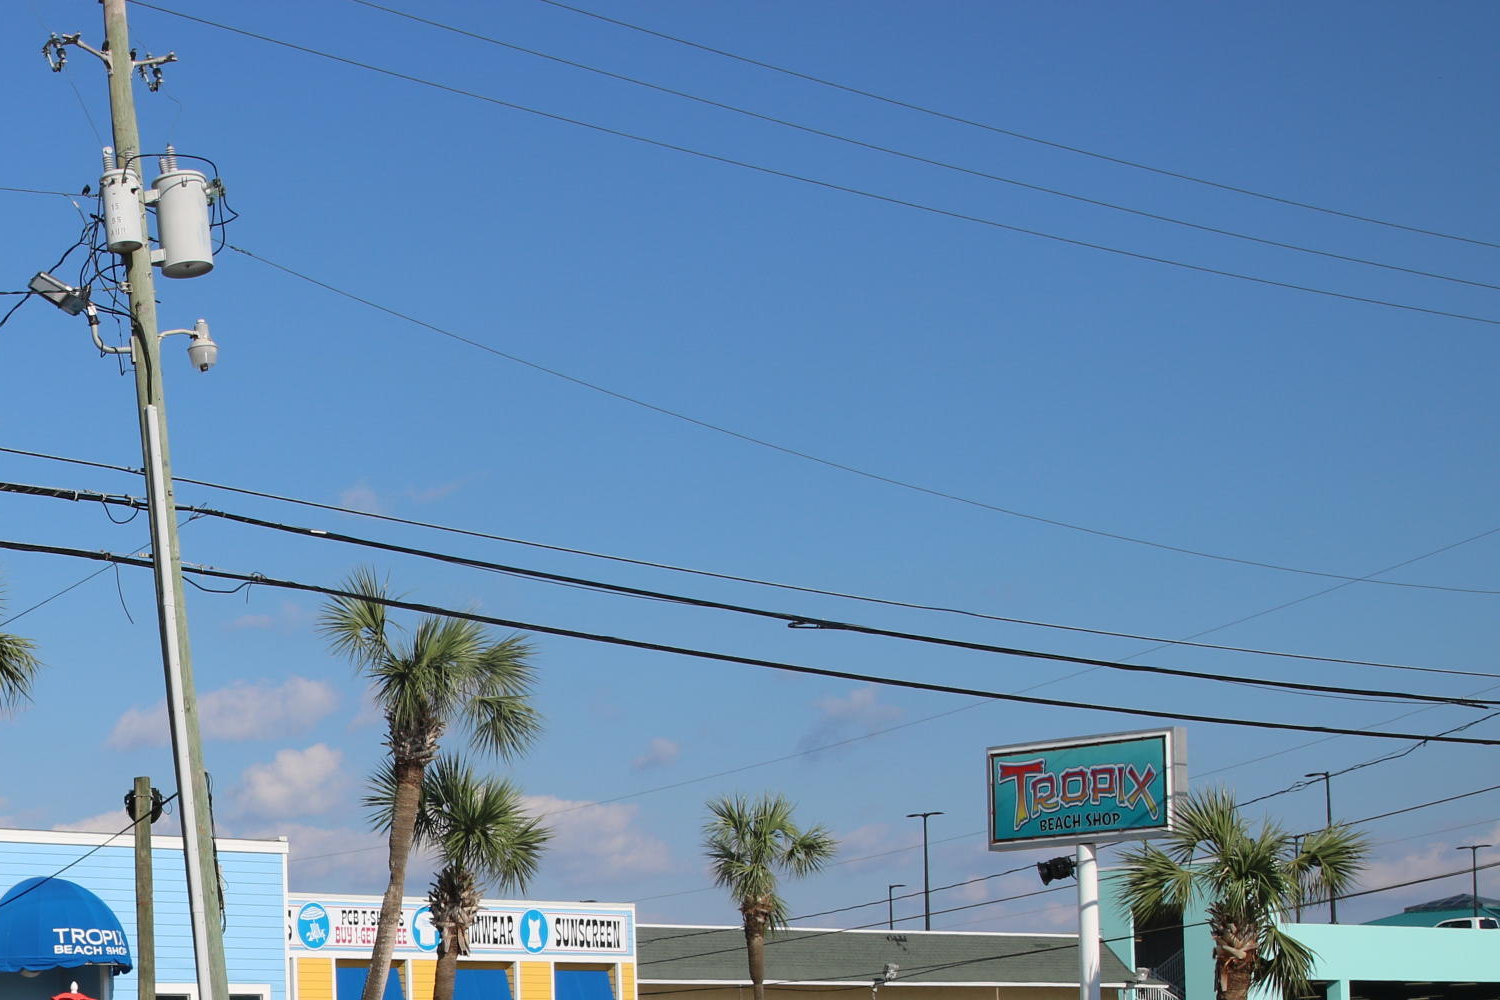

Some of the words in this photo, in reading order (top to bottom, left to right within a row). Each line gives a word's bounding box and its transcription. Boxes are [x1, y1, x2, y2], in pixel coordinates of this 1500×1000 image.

[998, 757, 1159, 831] TROPIX
[1040, 813, 1081, 832] BEACH
[1085, 812, 1121, 827] SHOP
[341, 910, 359, 926] PCB
[362, 911, 404, 927] T-SHS
[52, 928, 125, 946] TROPIX
[336, 926, 352, 944] BUY
[468, 915, 514, 946] MWEAR
[555, 917, 621, 948] SUNSCREEN
[53, 944, 102, 955] BEACH
[105, 946, 127, 956] SHOP
